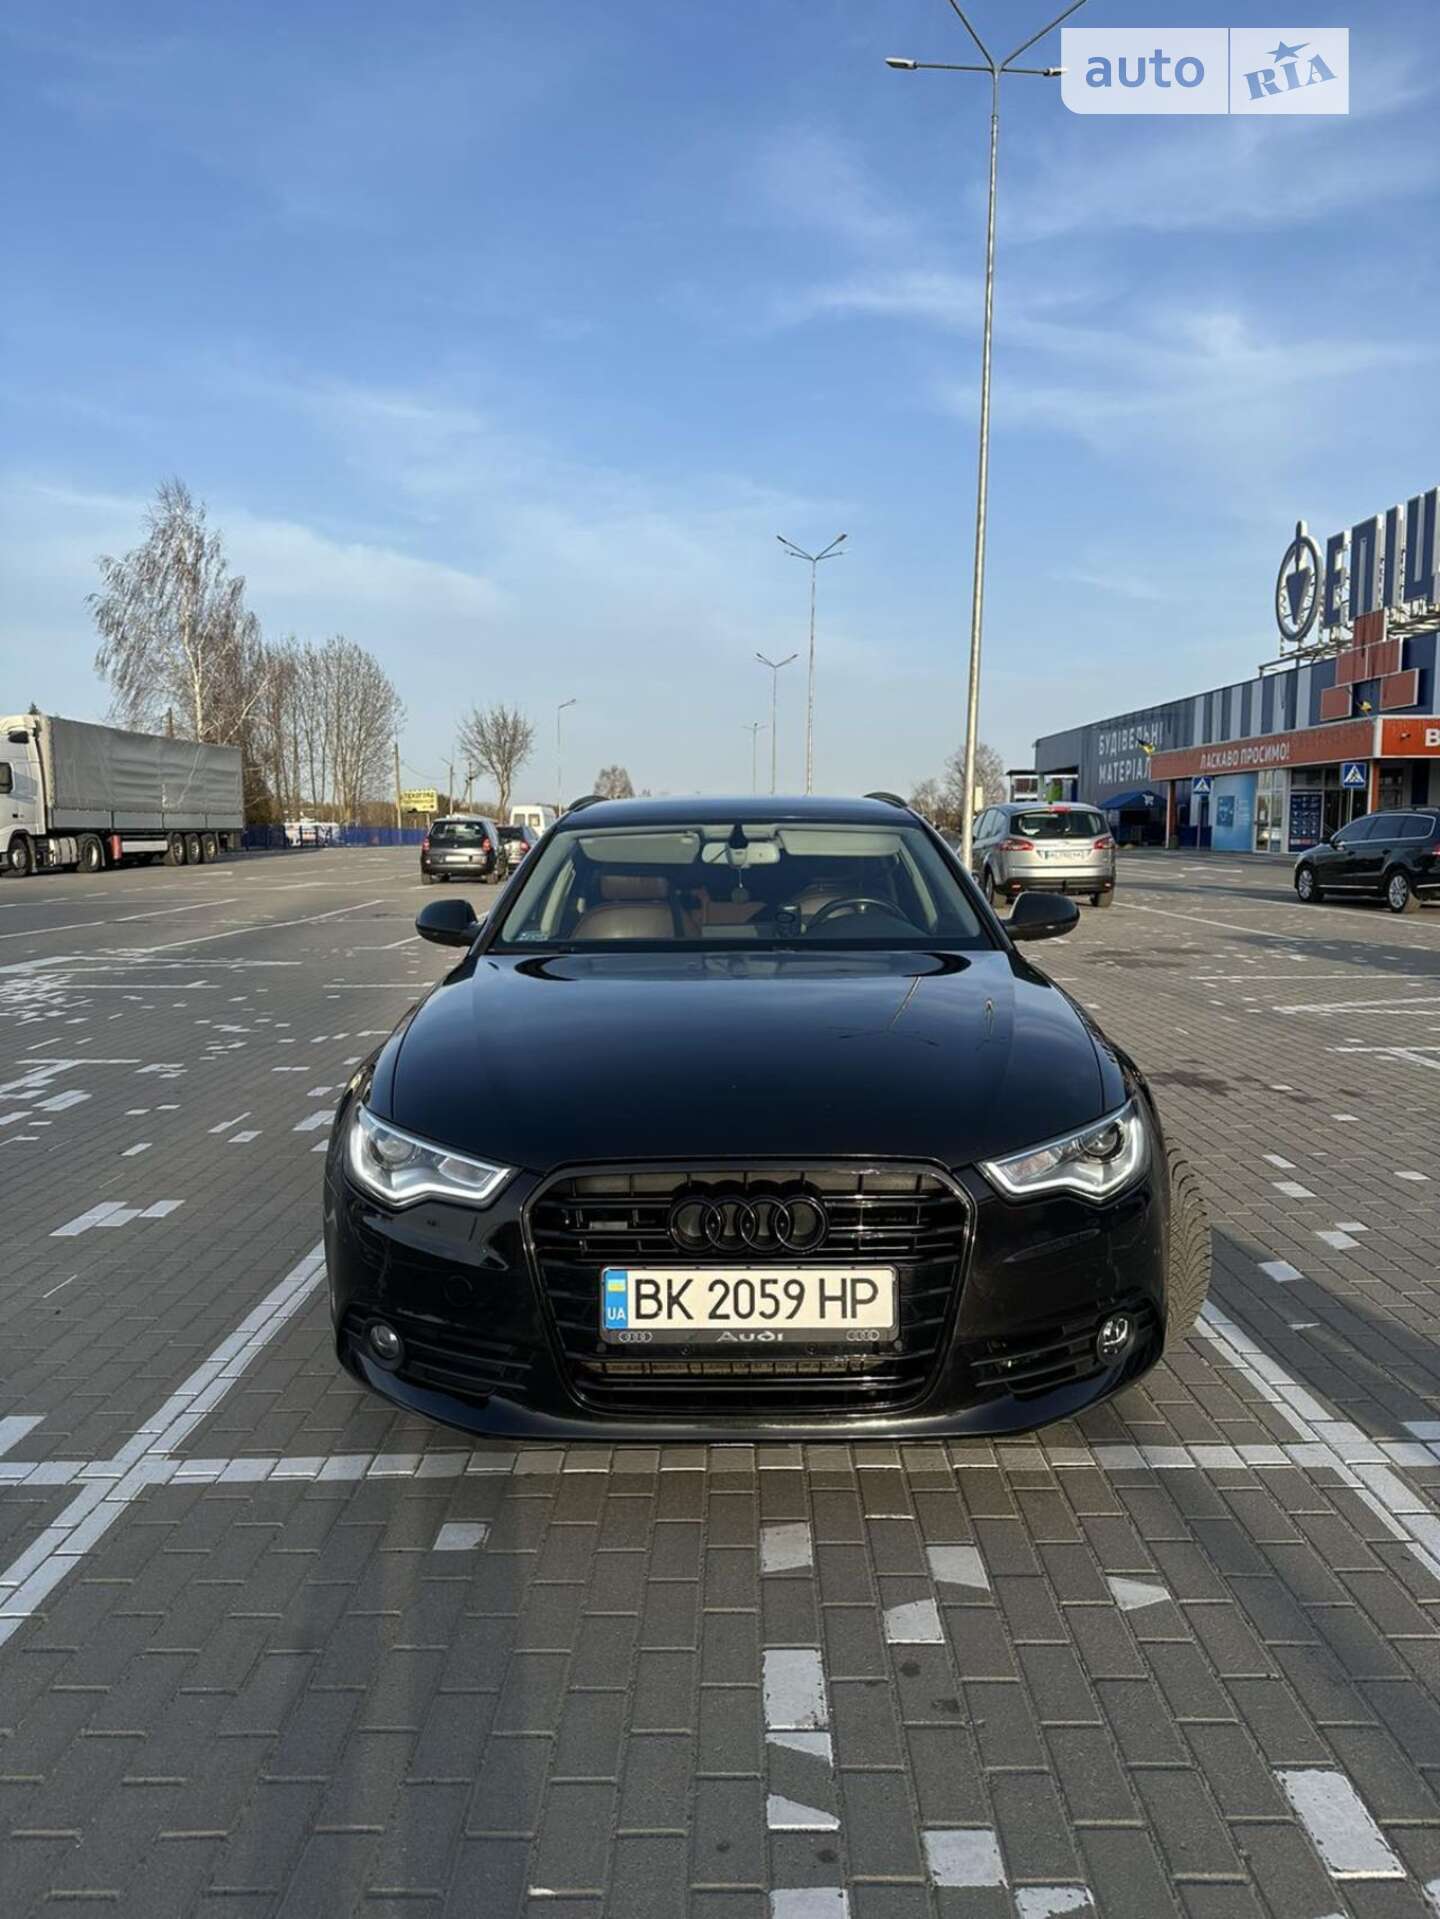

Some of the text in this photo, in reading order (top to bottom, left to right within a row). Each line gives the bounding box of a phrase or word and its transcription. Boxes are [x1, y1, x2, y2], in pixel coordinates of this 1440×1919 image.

[1199, 740, 1291, 770] ЛАСКАВО ПРОСИМО!
[634, 1277, 879, 1320] BK 2059 HP
[607, 1307, 626, 1321] UA
